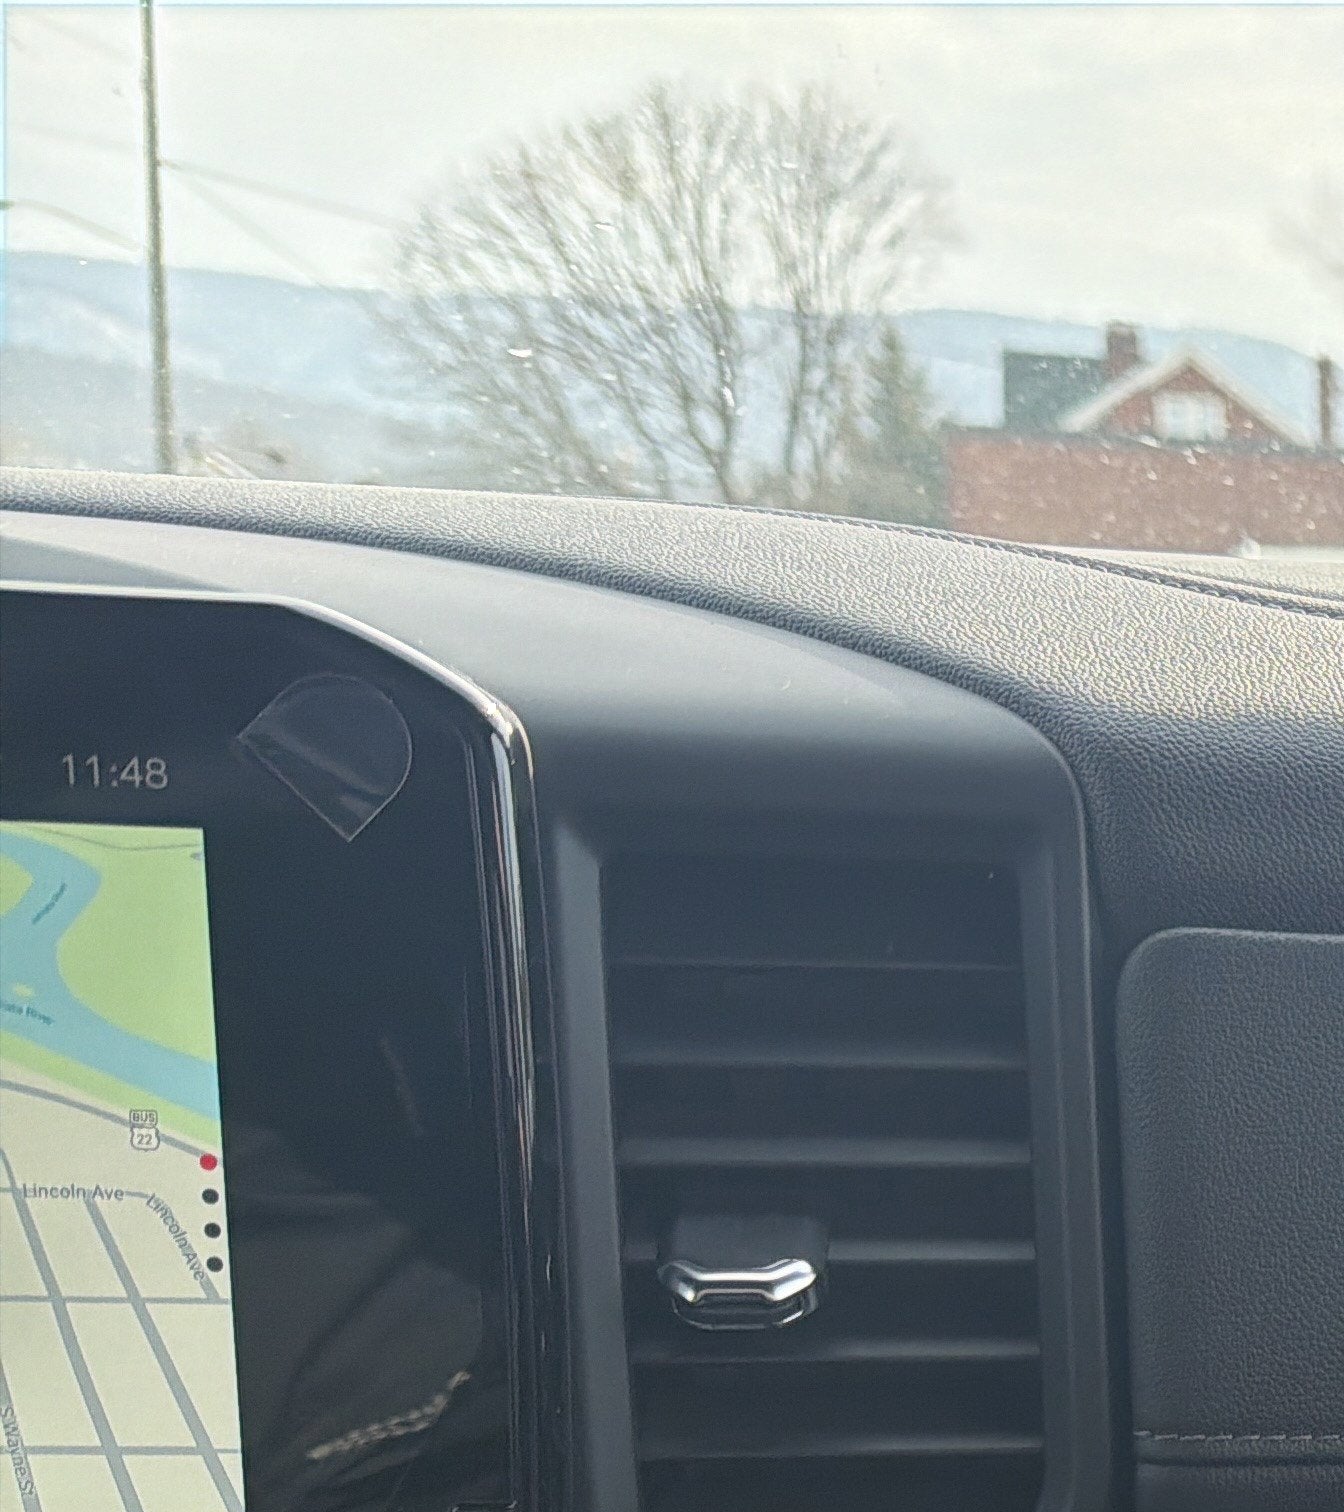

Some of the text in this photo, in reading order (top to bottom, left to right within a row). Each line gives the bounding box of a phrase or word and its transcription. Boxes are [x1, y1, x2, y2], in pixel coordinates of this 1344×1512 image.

[62, 753, 168, 789] 11:48
[132, 1112, 155, 1122] BUS
[137, 1133, 152, 1145] 22
[22, 1183, 125, 1201] Lincoln Ave
[145, 1192, 205, 1281] Lincoln Ave
